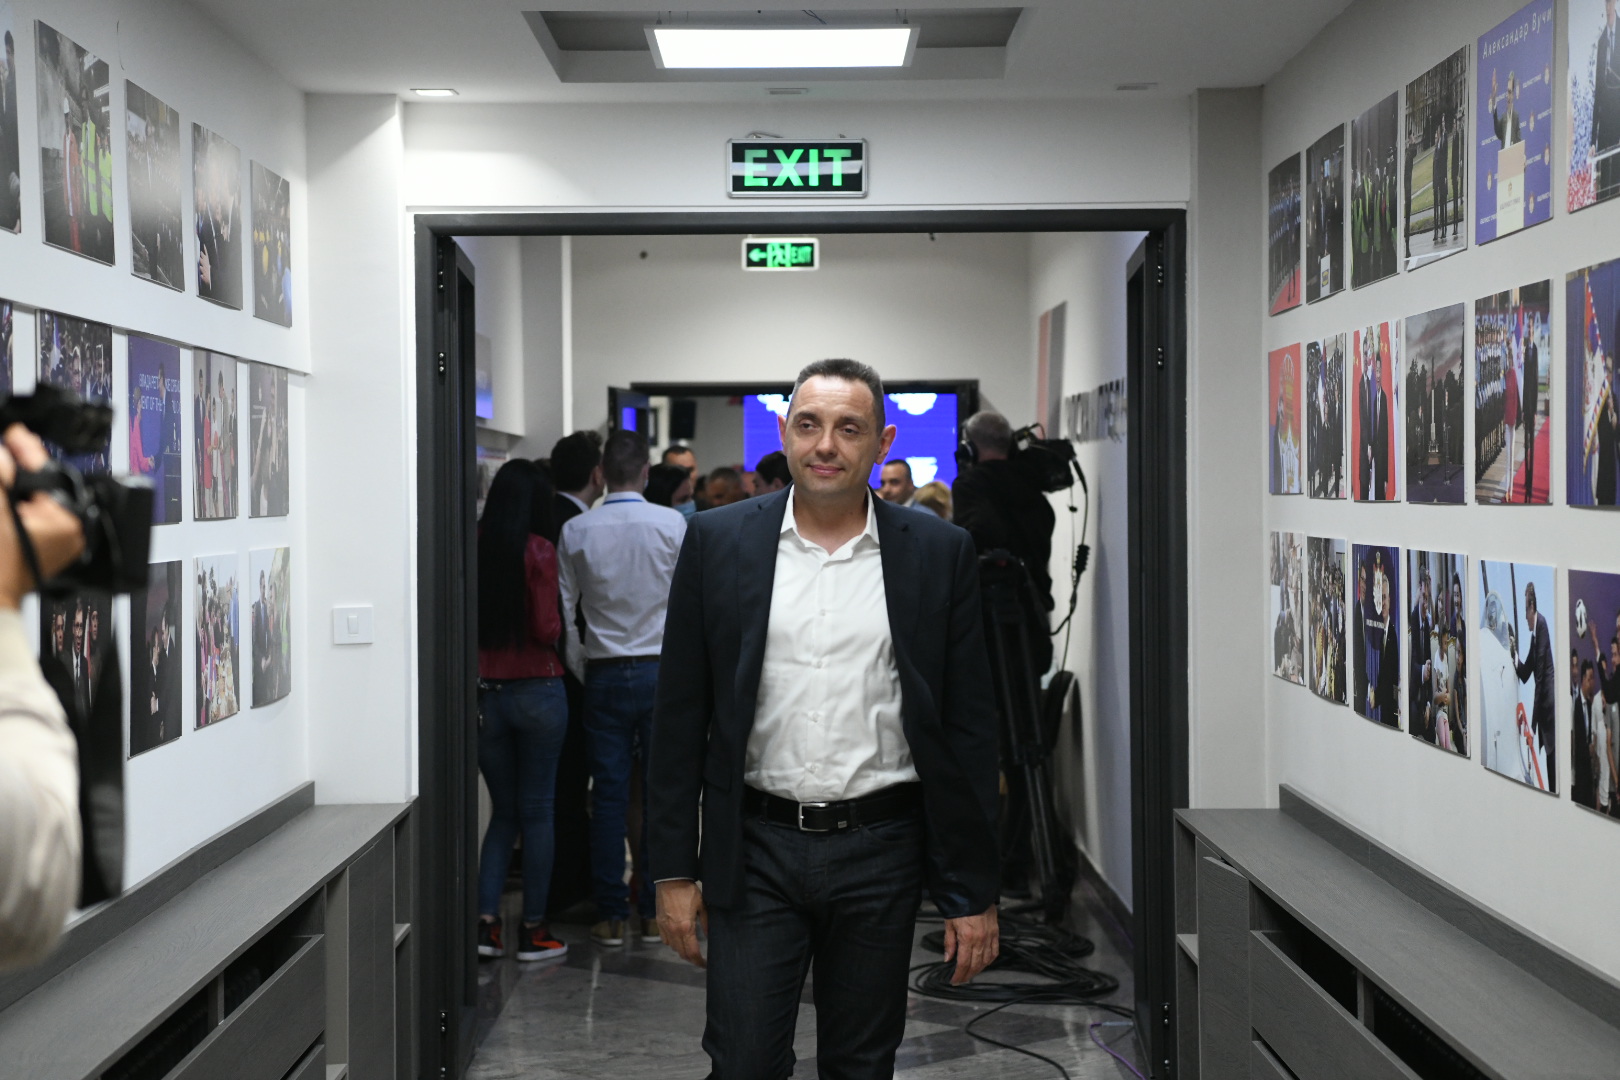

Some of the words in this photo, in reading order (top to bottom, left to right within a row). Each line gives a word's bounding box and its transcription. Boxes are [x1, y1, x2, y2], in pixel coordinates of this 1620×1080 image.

[1483, 23, 1529, 60] Александар
[744, 149, 852, 186] EXIT
[791, 246, 812, 263] EXIT
